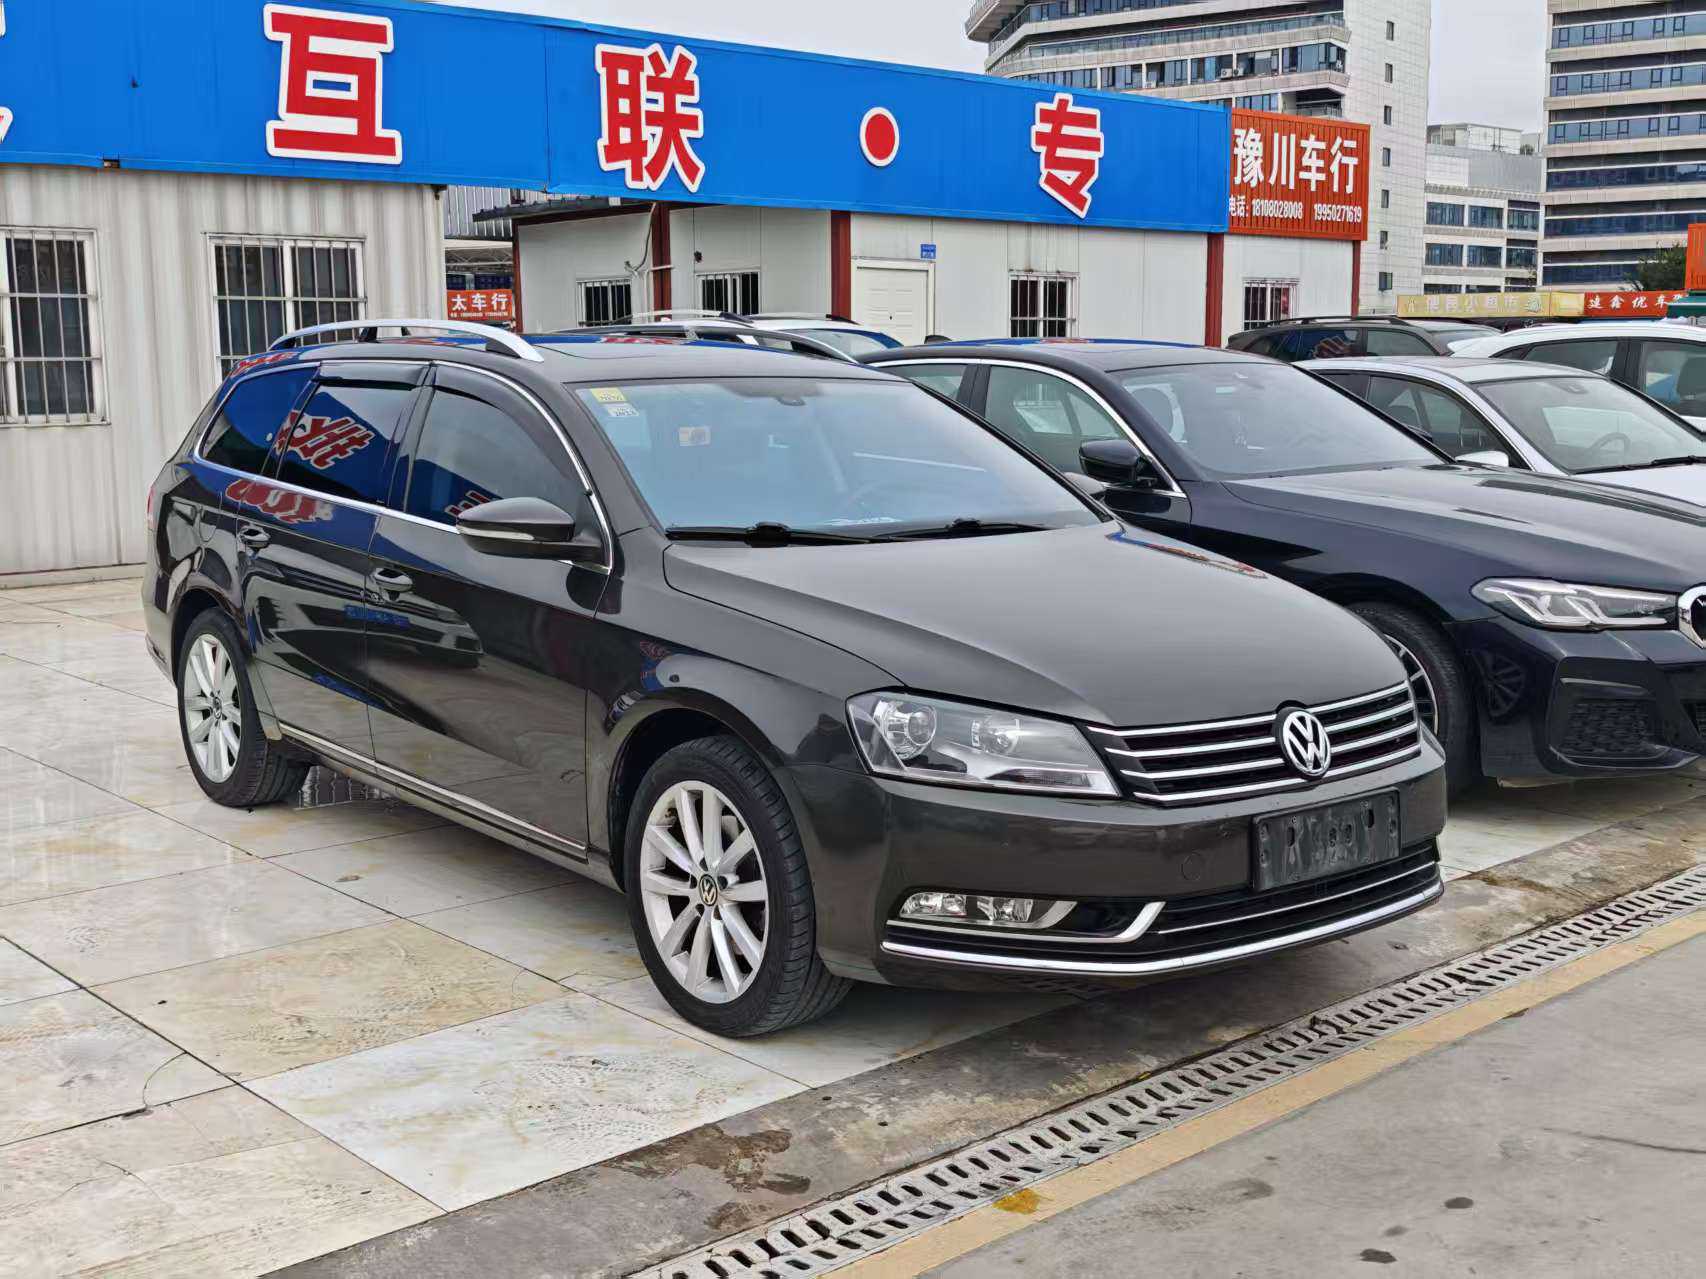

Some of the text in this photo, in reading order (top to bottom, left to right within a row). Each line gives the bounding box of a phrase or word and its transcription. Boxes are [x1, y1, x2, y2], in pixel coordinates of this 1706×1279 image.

[265, 5, 1104, 218] 互 联 专
[1233, 127, 1359, 194] 豫川车行
